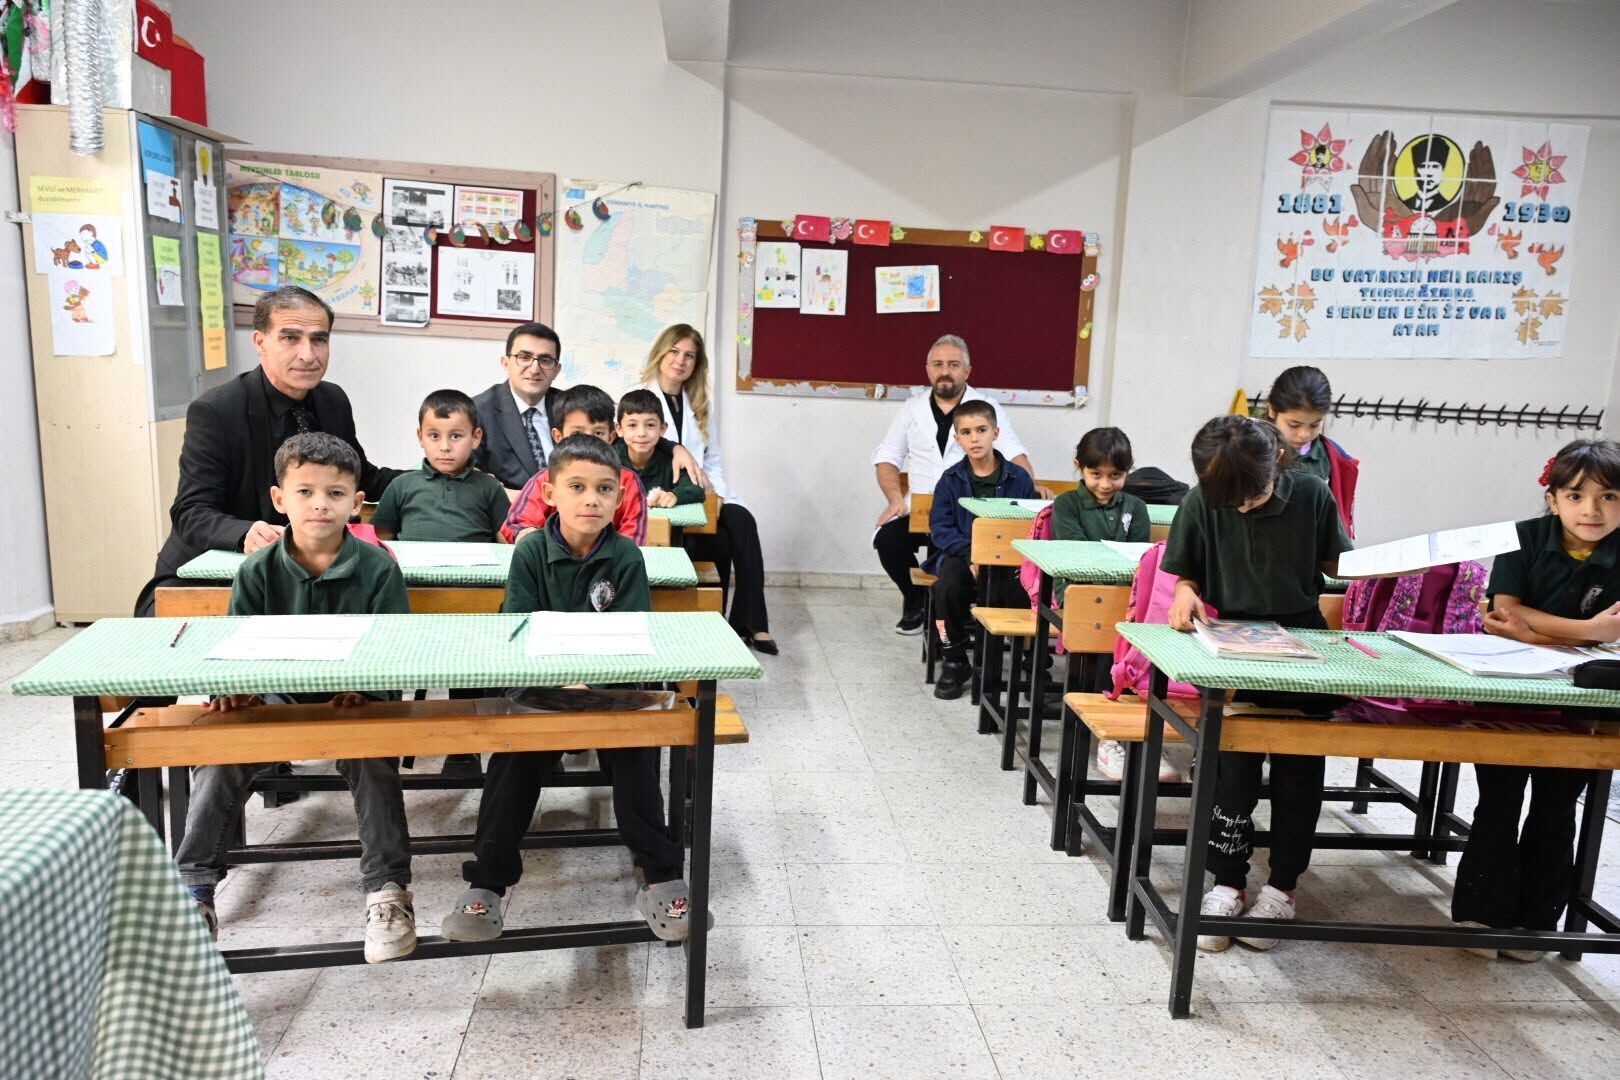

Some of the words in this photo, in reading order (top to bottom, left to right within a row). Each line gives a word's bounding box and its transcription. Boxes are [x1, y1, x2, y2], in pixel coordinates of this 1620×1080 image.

[284, 169, 320, 179] TABLOSU
[37, 185, 56, 193] SEVGİ
[1277, 193, 1343, 214] 1881
[1502, 202, 1571, 223] 1938
[1311, 268, 1336, 282] BU
[1342, 269, 1424, 284] VATANIN
[1326, 304, 1400, 319] SENDEN
[1404, 303, 1438, 319] BİR
[1469, 306, 1507, 320] VAR
[1393, 323, 1440, 337] ATAM
